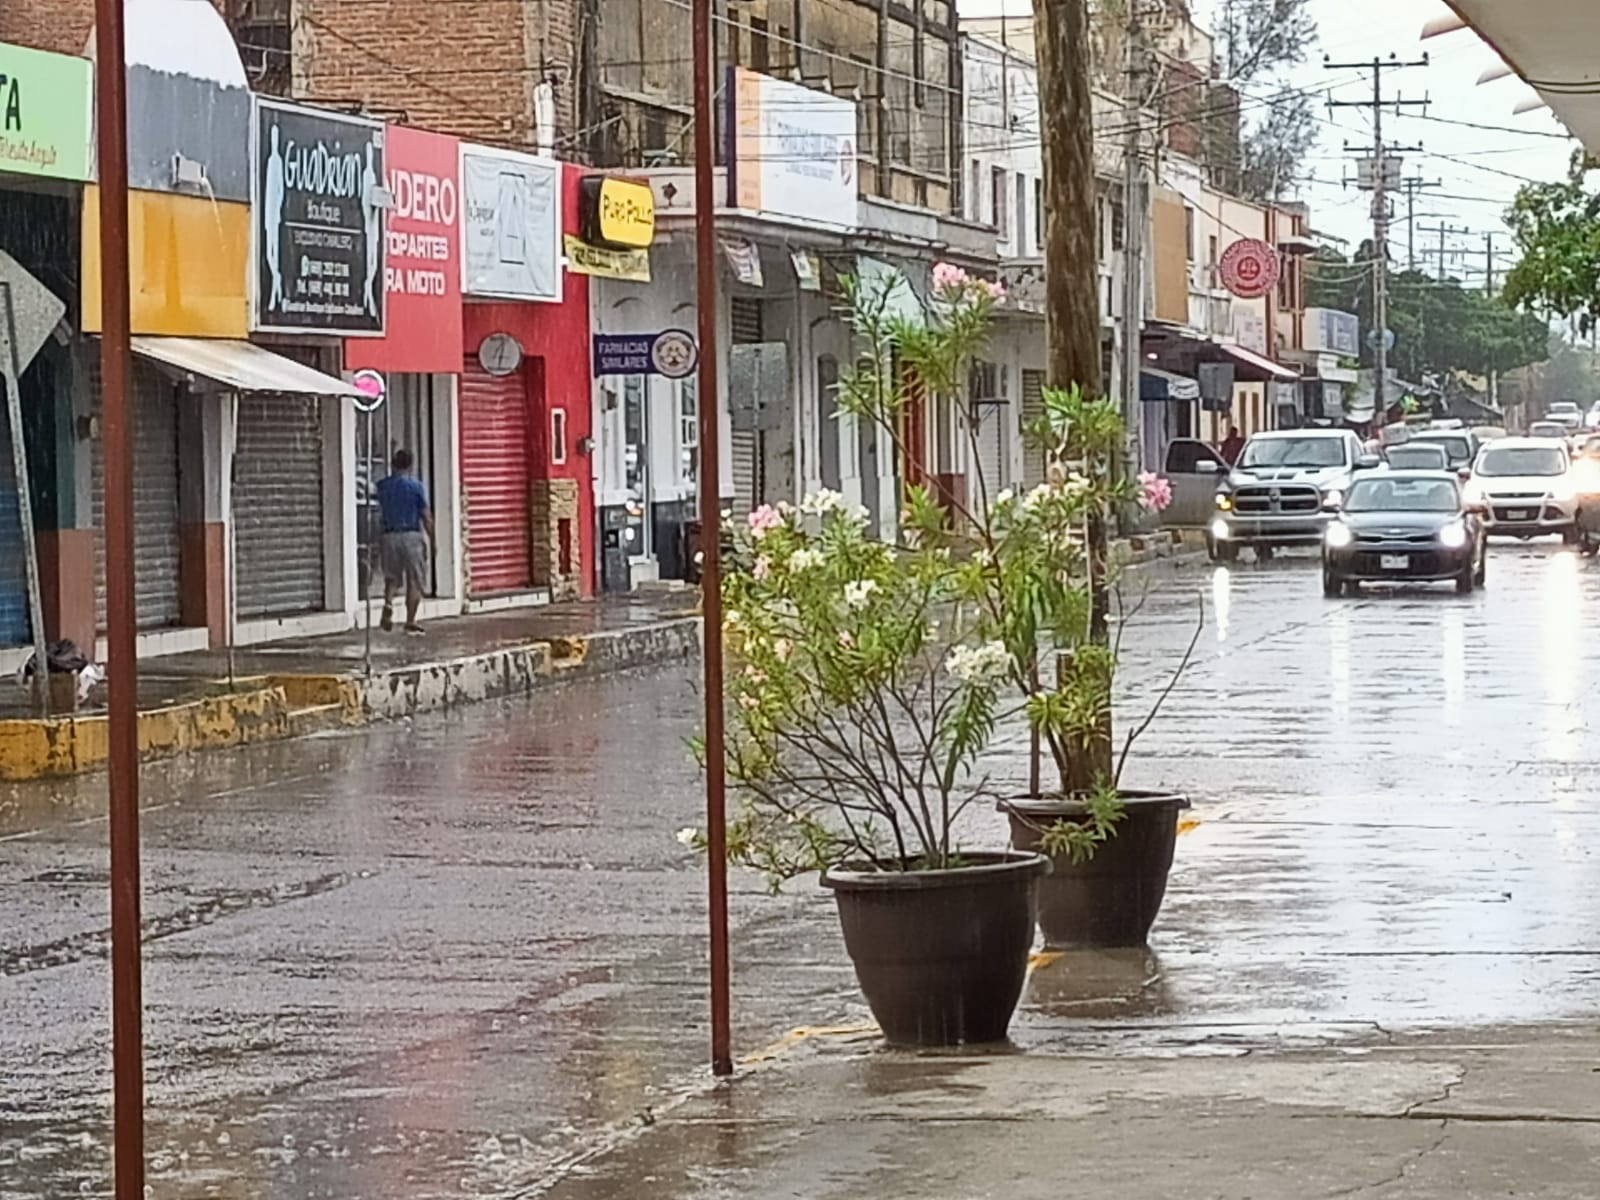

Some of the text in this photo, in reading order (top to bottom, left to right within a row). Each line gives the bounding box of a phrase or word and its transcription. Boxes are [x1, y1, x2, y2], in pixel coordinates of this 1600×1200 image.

[407, 269, 445, 295] MOTO
[598, 341, 648, 355] FARMACIAS
[601, 356, 648, 369] SIMILARES
